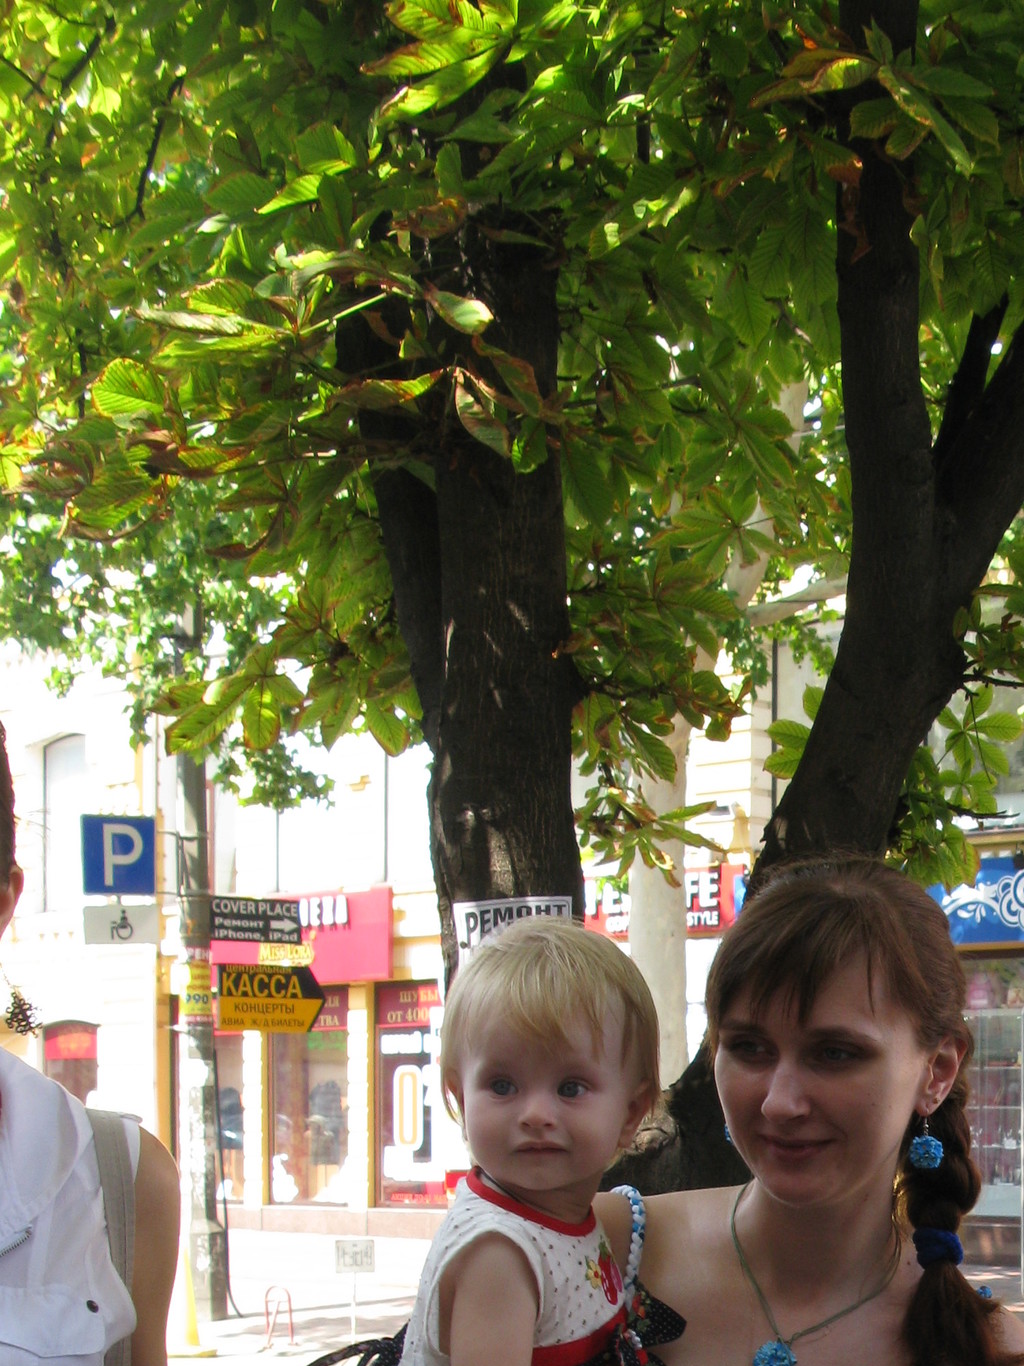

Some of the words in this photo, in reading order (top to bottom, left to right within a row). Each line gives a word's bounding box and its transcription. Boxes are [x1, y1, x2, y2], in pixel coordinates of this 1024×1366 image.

[102, 823, 143, 887] P
[212, 899, 255, 915] COVER
[258, 900, 298, 918] PLACE
[214, 916, 264, 928] Ремонт
[686, 911, 719, 926] STYLE
[214, 928, 264, 941] iPhone,
[269, 931, 298, 942] iPad
[221, 972, 303, 998] КАССА
[400, 989, 438, 1003] ШУБЫ
[234, 1002, 295, 1015] КОНЦЕРТЫ
[387, 1010, 403, 1024] ОТ
[406, 1007, 430, 1023] 400
[221, 1017, 245, 1026] АВИА
[270, 1018, 305, 1027] БИЛЕТЫ
[314, 1014, 340, 1028] ТВА
